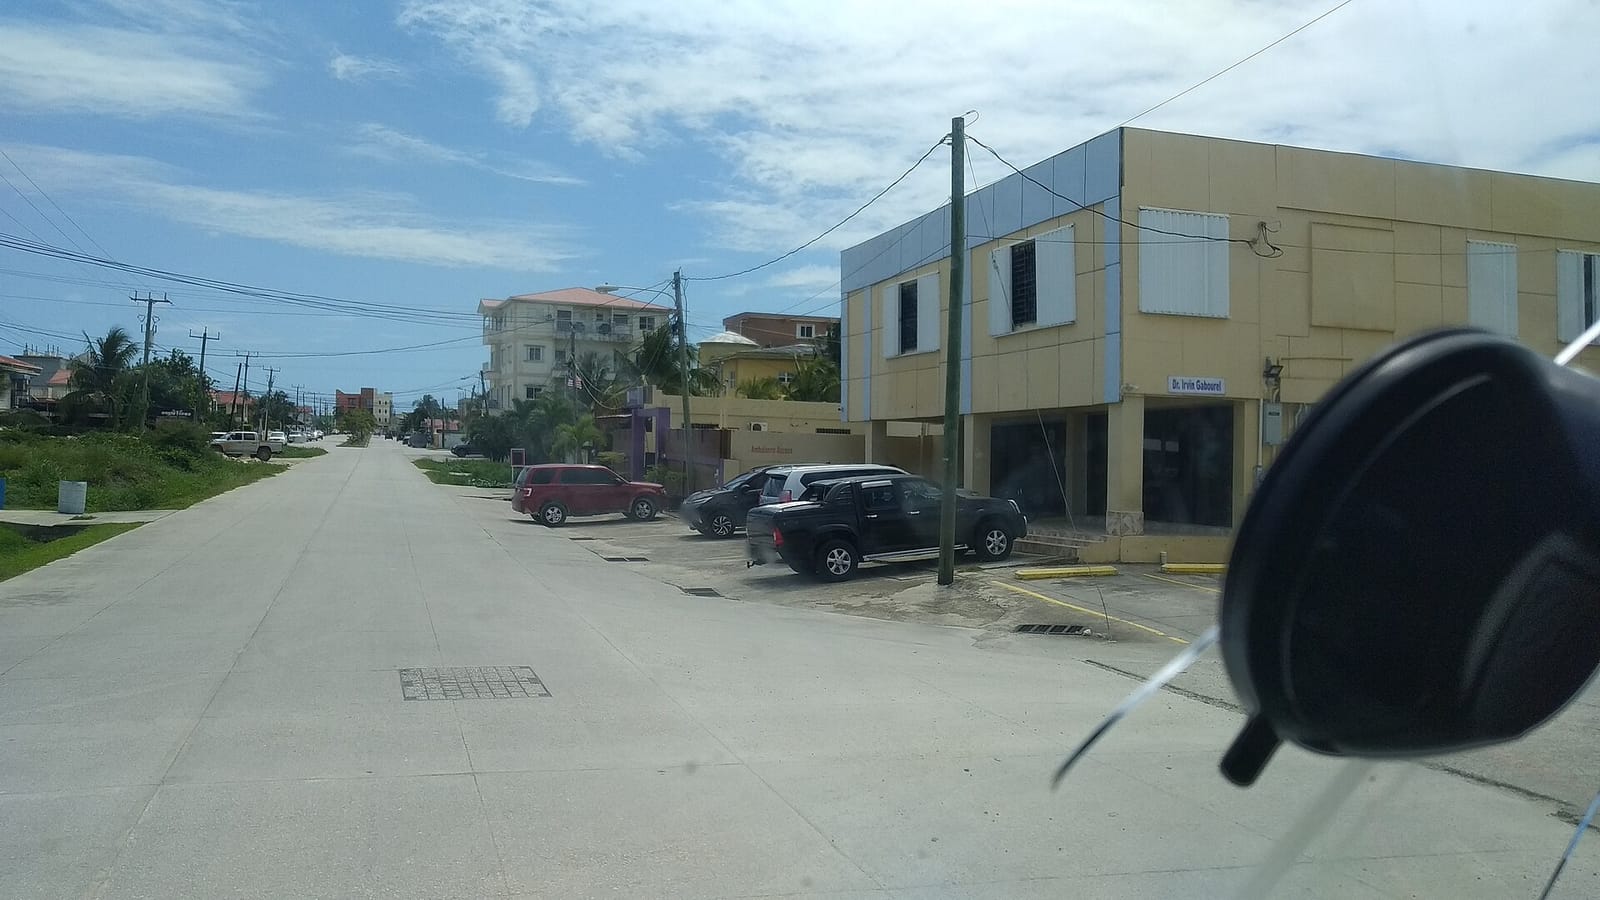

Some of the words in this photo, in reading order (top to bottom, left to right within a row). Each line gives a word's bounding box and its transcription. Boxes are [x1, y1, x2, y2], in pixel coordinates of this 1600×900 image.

[1172, 378, 1180, 390] Dr.
[1182, 379, 1195, 391] Irvin
[1196, 380, 1221, 392] Gabourel
